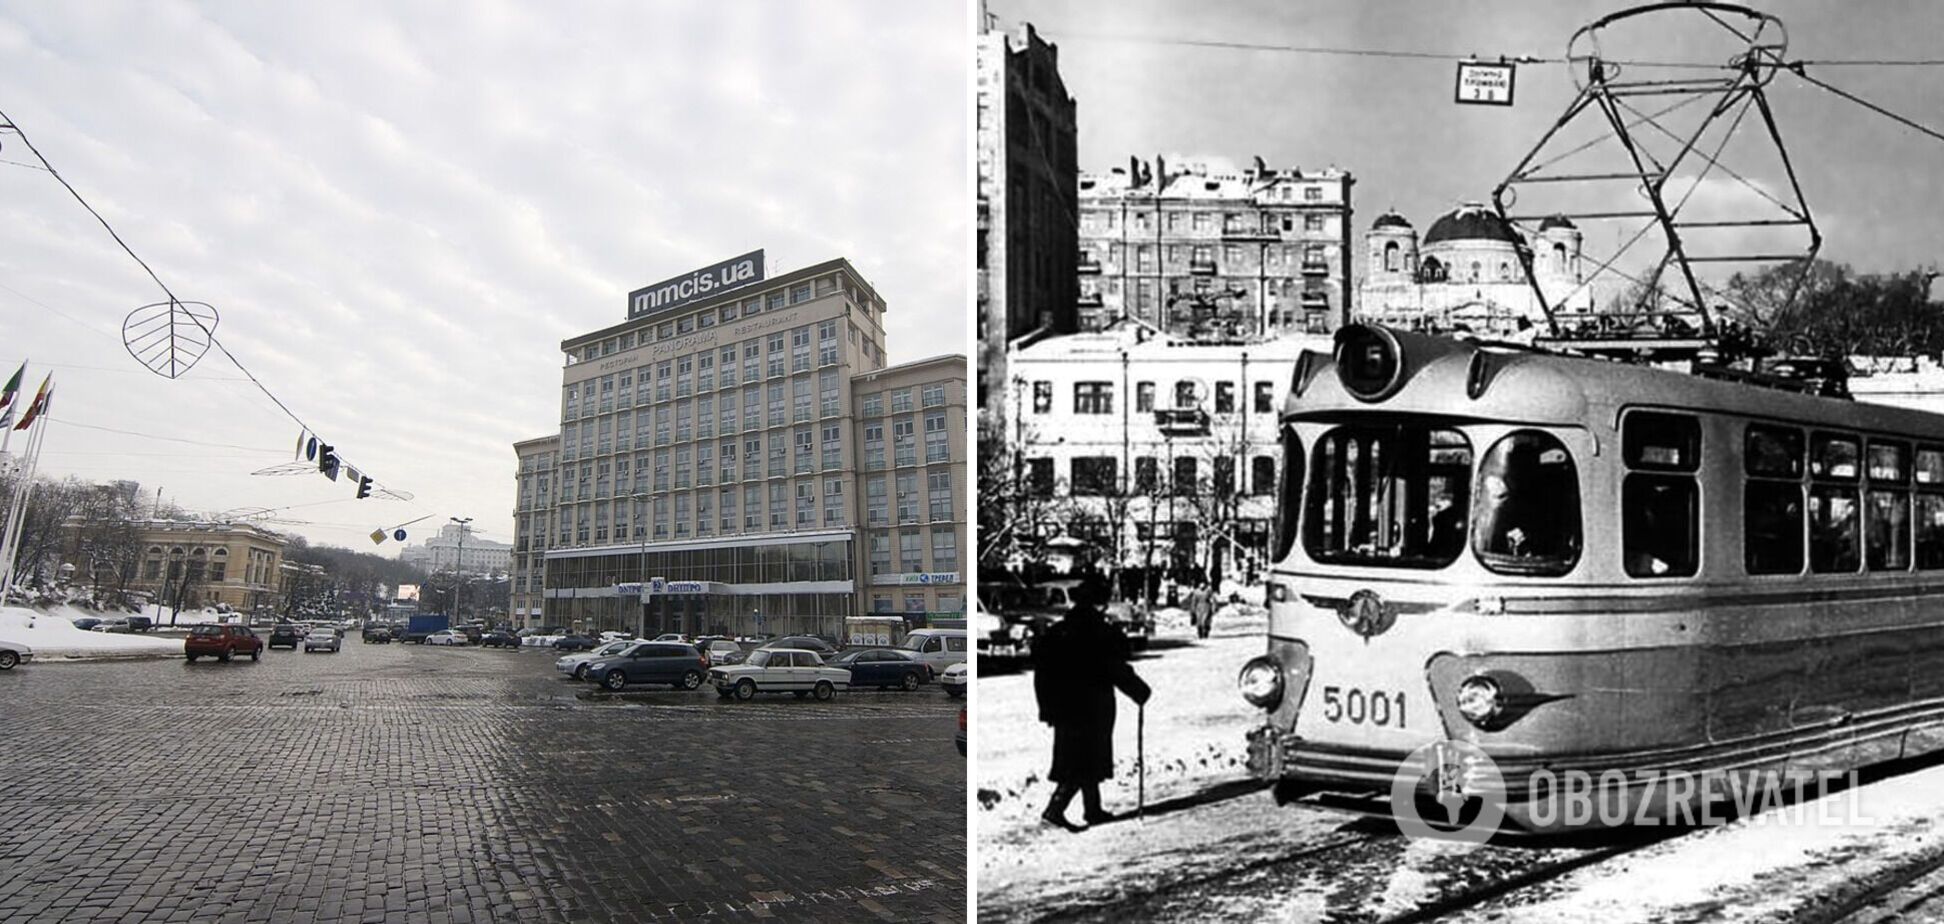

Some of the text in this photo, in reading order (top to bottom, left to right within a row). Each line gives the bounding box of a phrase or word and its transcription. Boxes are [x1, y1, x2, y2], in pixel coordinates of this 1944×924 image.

[634, 259, 755, 313] mmcis.ua
[652, 329, 718, 355] PANORAMA
[734, 312, 800, 336] RESTAURANT
[1324, 686, 1406, 729] 5001
